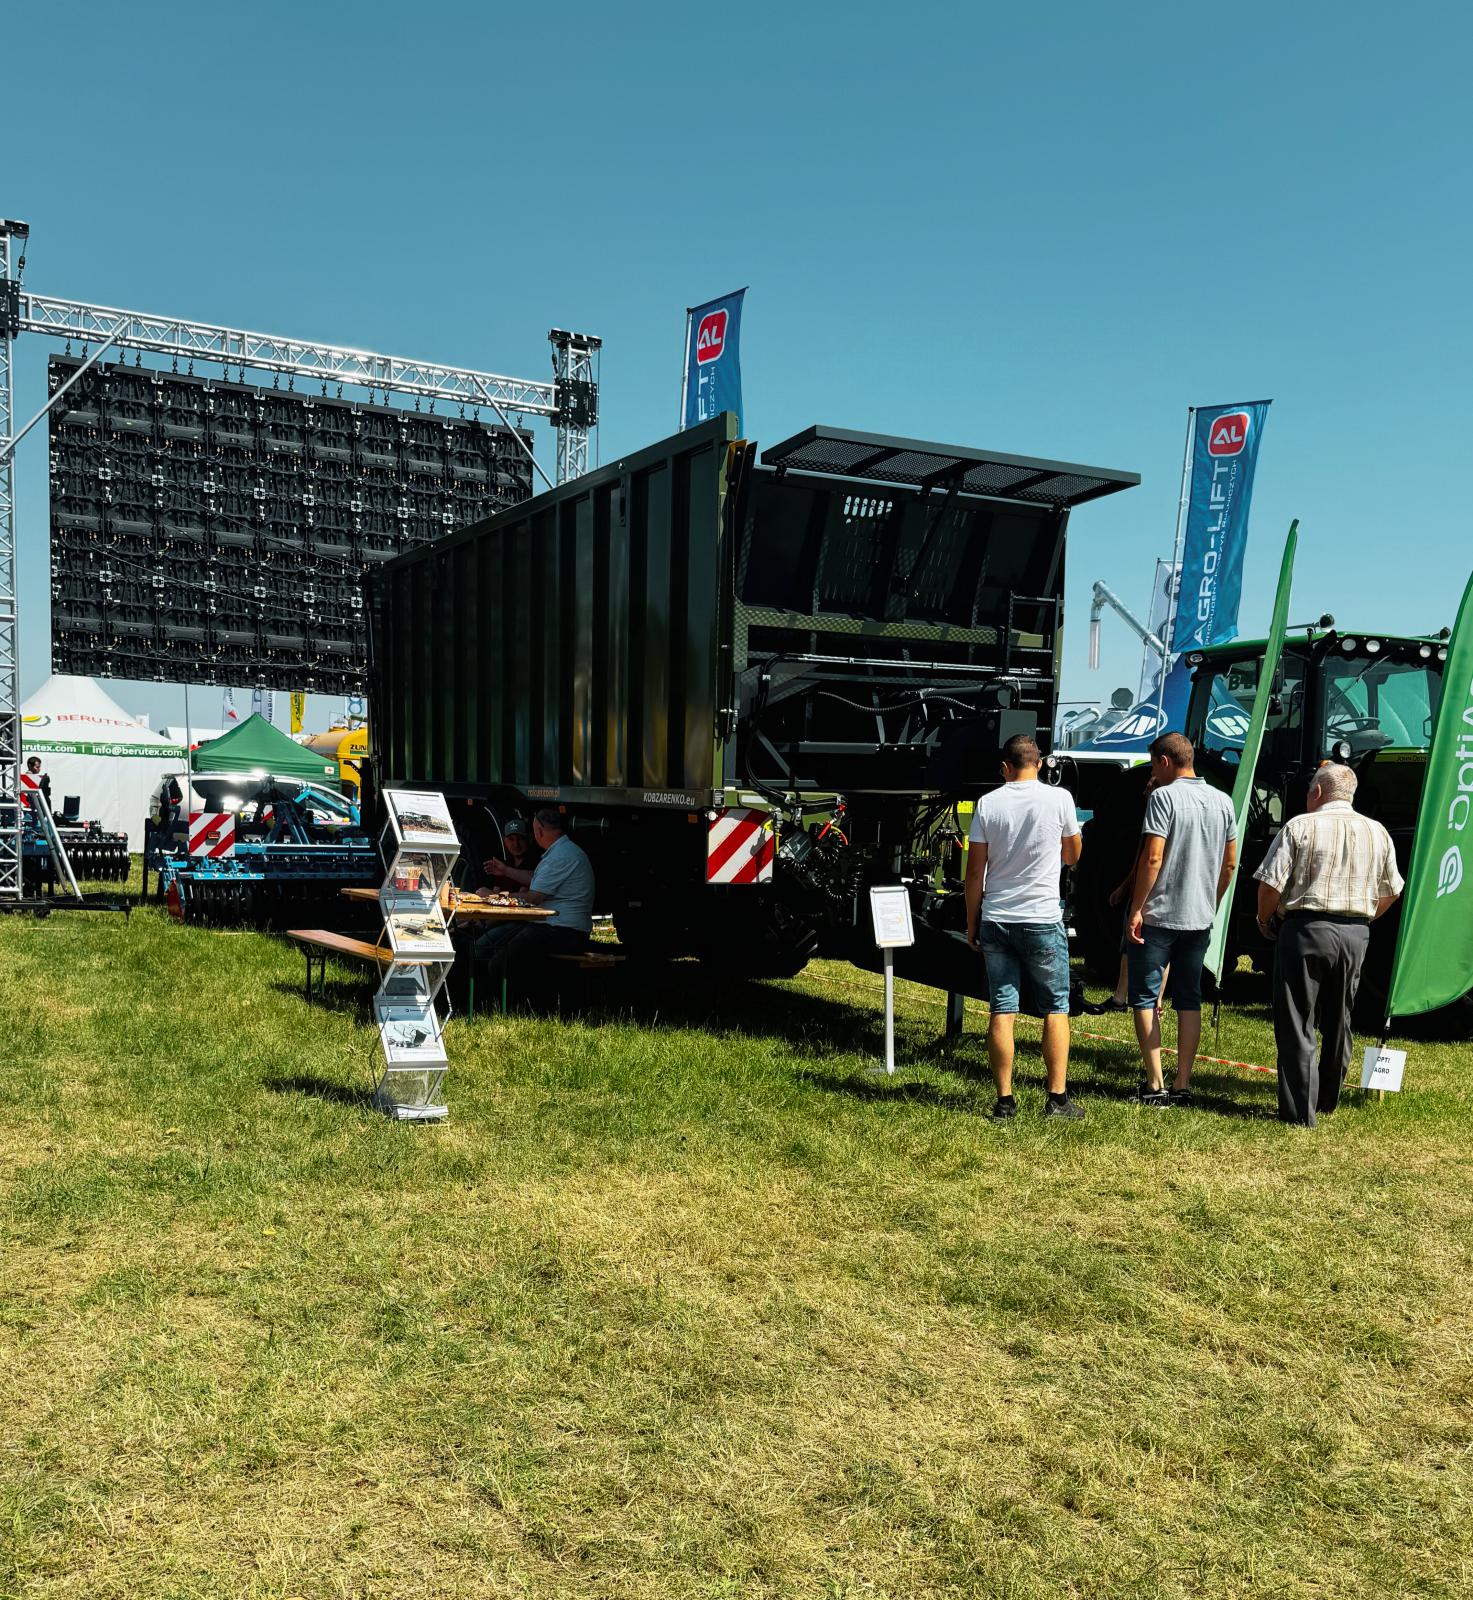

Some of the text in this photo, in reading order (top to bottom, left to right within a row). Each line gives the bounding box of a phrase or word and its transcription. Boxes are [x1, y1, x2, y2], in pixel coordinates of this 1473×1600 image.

[1213, 425, 1243, 445] AL
[1193, 459, 1229, 646] AGRO-LIFT
[57, 714, 135, 728] BERUTEX
[92, 746, 183, 757] info@berutex.com
[643, 792, 695, 806] KOBZARENKO.eu
